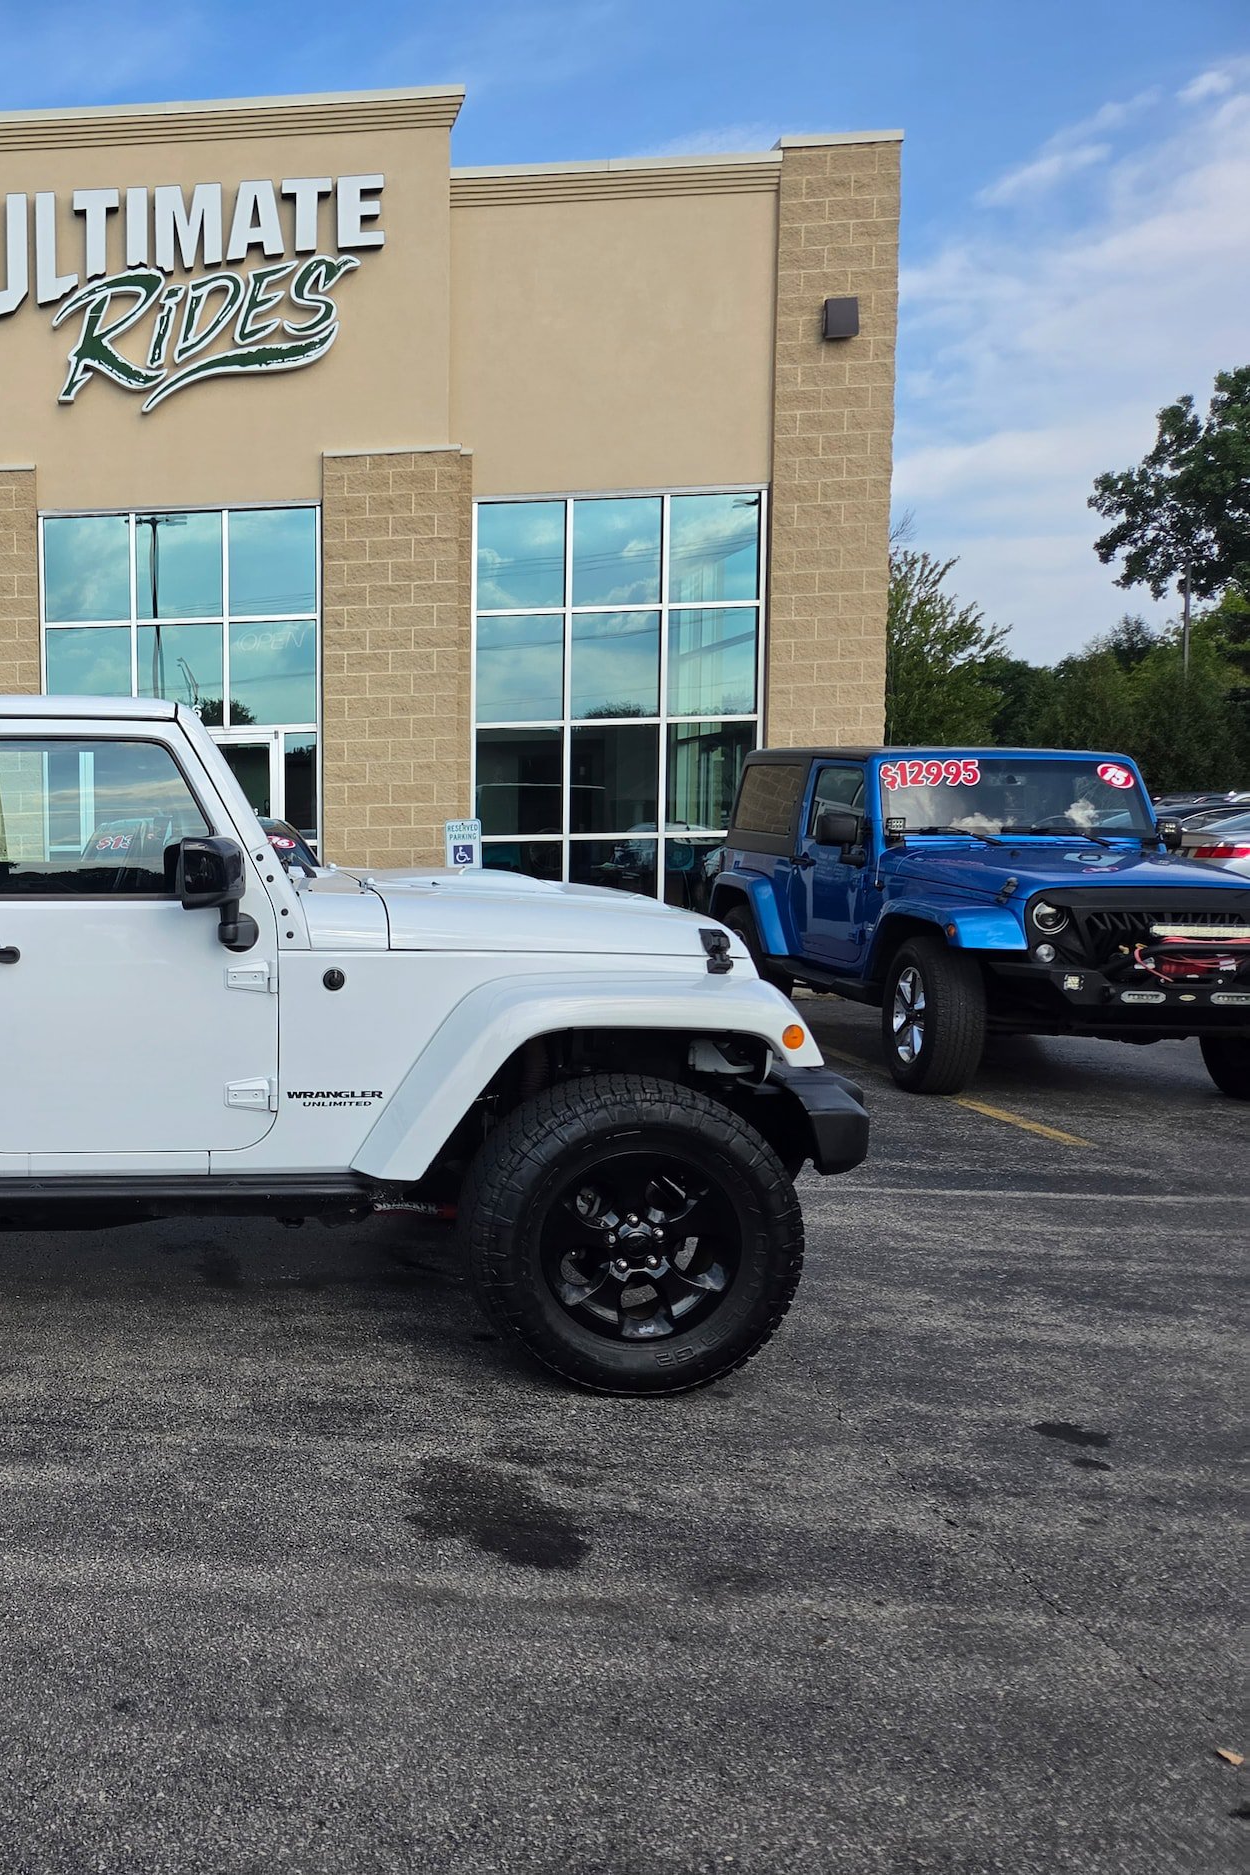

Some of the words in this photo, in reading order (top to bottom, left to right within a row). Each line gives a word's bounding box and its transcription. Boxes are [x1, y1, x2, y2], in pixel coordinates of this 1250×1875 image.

[240, 631, 305, 651] OPEN
[880, 759, 981, 791] $12995
[1102, 767, 1129, 785] 15
[447, 823, 479, 832] RESERVED
[286, 1090, 384, 1099] WRANGLER
